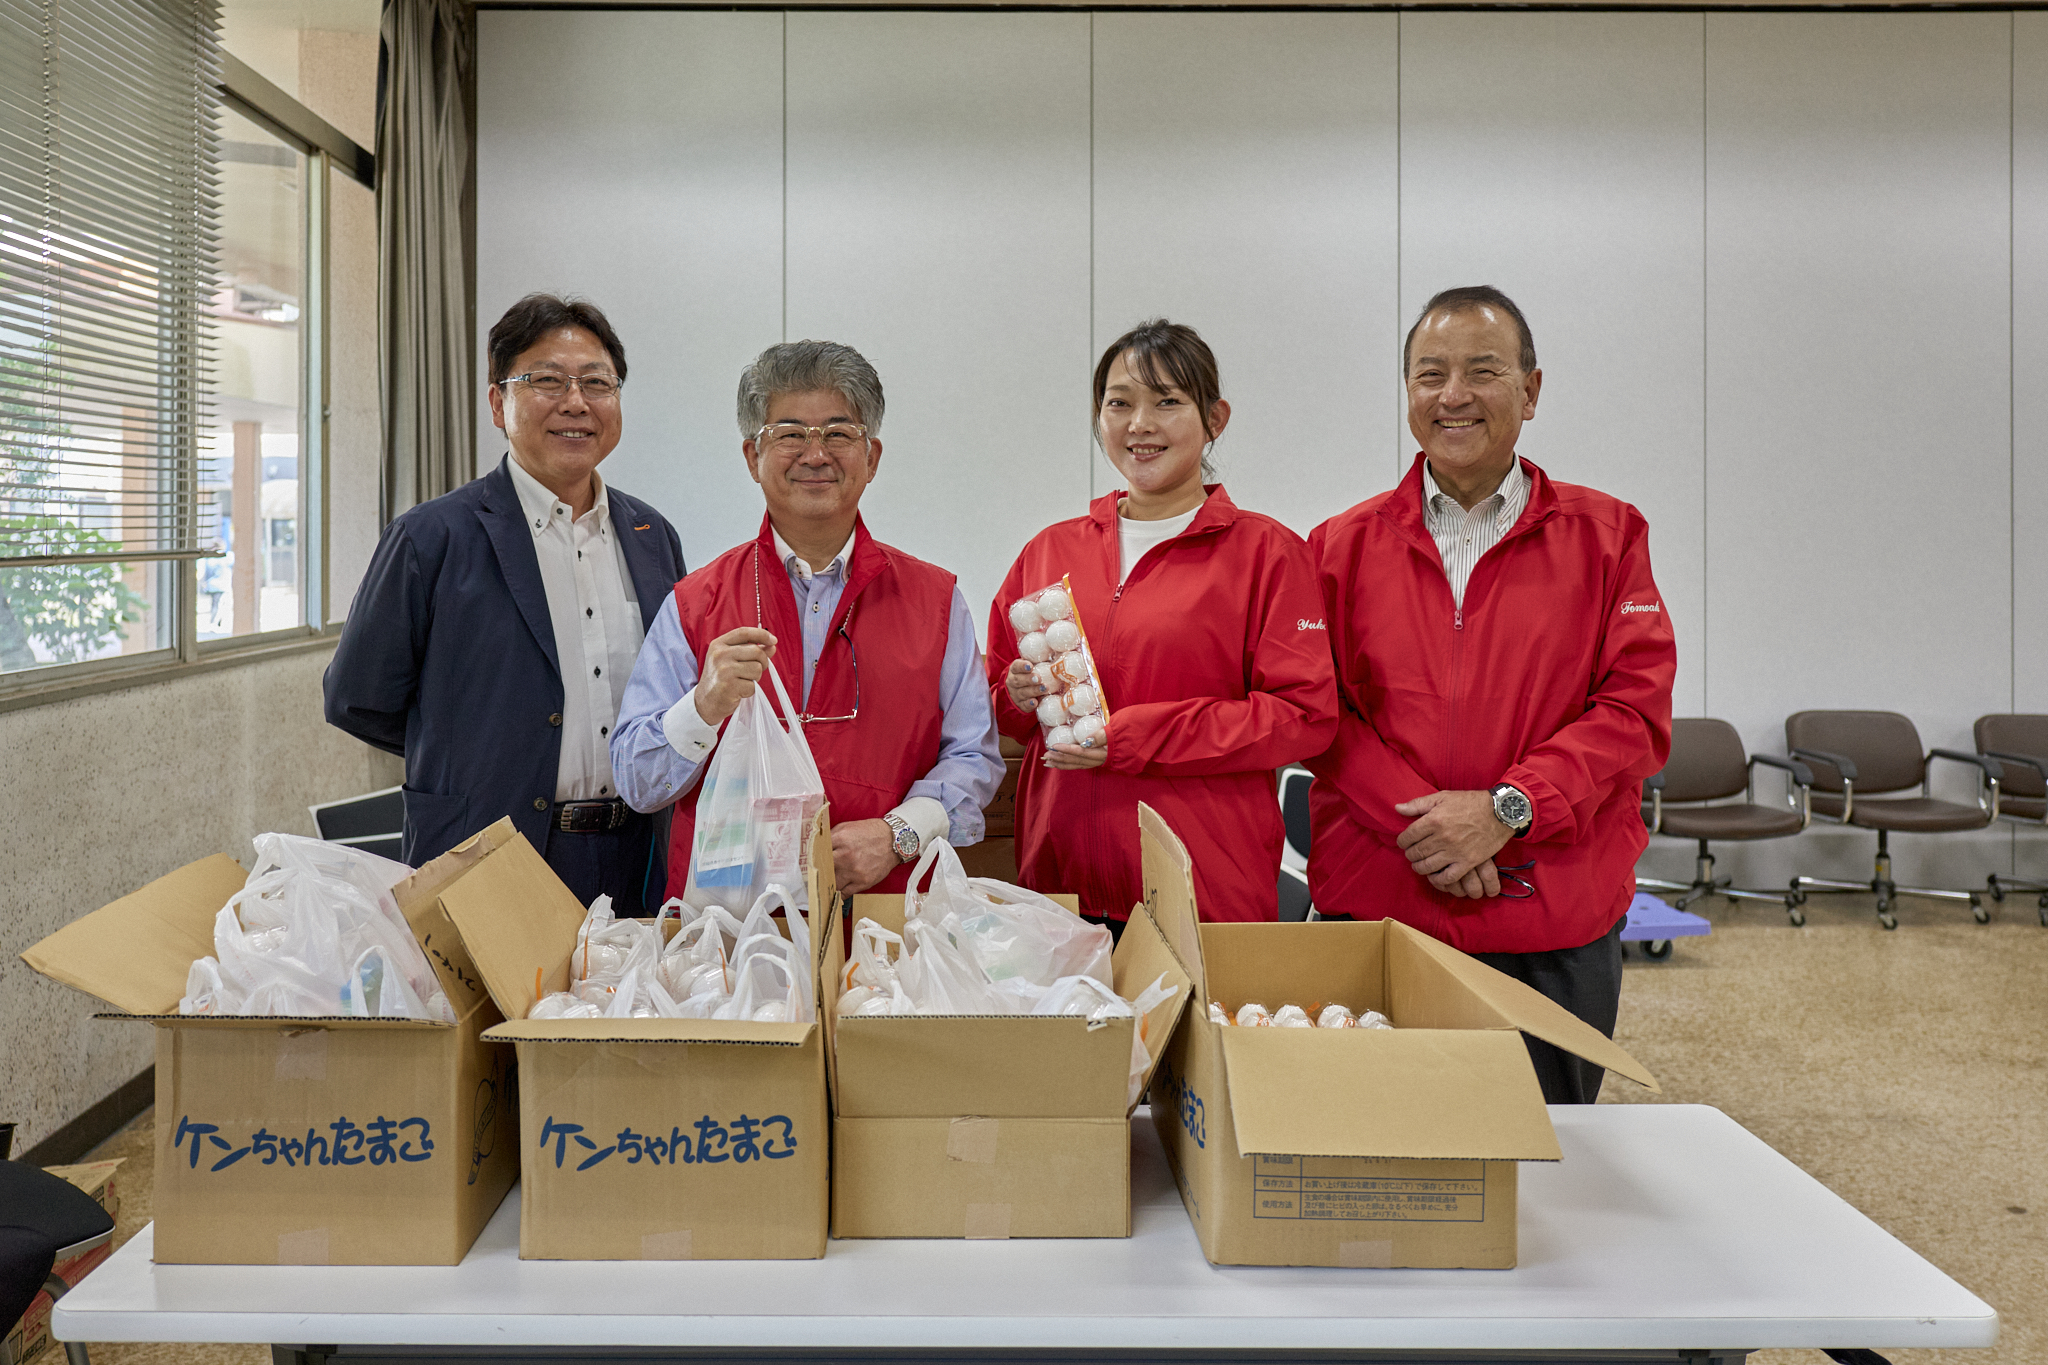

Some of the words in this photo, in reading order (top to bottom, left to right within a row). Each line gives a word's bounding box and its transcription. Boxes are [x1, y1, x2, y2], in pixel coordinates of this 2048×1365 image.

[174, 1114, 435, 1172] ケンちゃんたまご
[539, 1113, 798, 1172] ケンちゃんたまご
[1262, 1179, 1294, 1188] 保存方法
[1262, 1200, 1293, 1209] 使用方法
